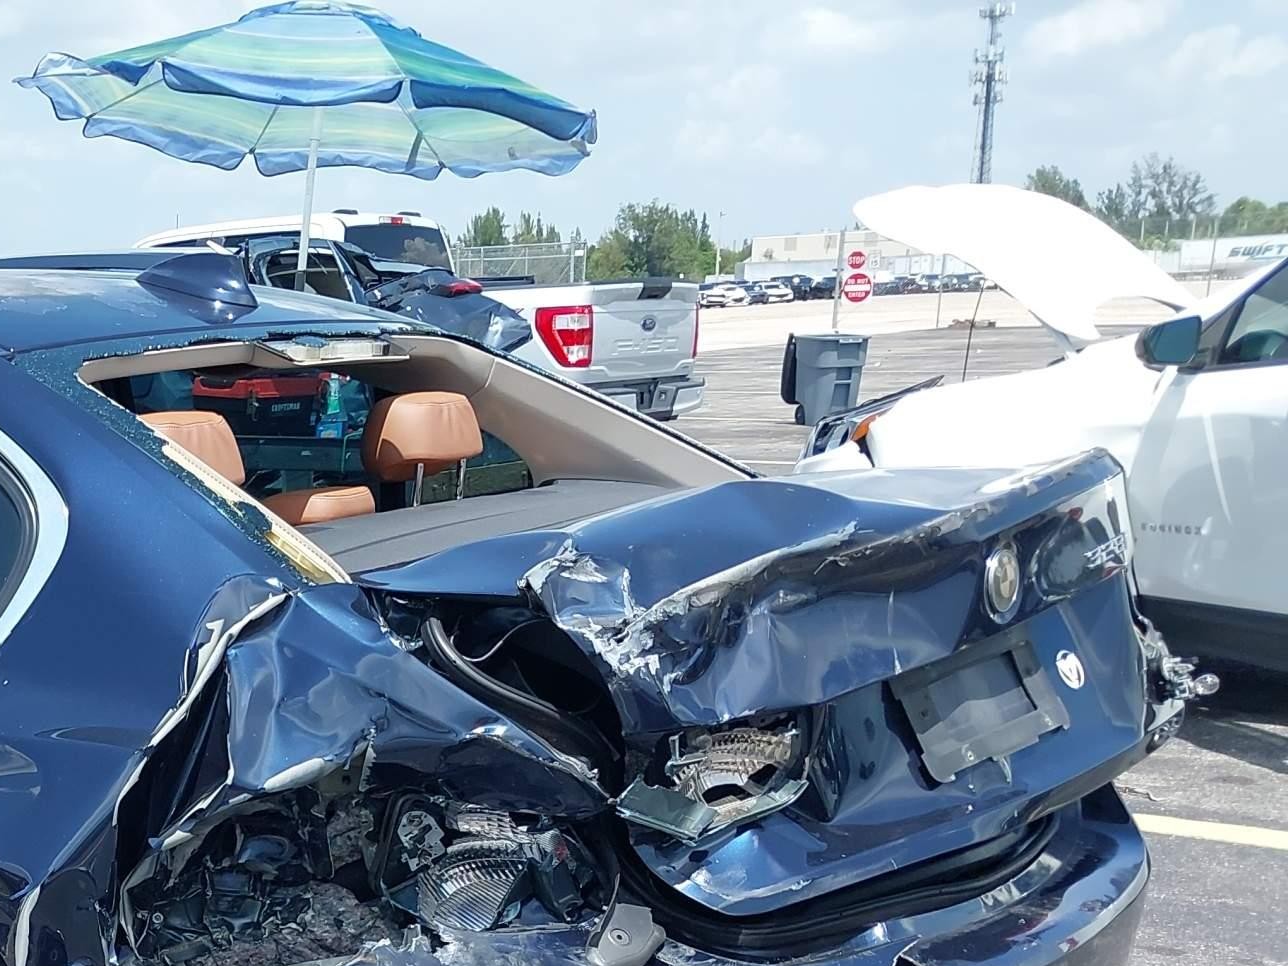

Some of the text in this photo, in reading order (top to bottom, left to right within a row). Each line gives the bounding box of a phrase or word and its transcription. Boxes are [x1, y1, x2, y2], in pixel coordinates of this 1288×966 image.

[1228, 243, 1288, 257] SWIFT
[847, 255, 865, 265] STOP
[271, 402, 301, 412] CRAFTSMAN
